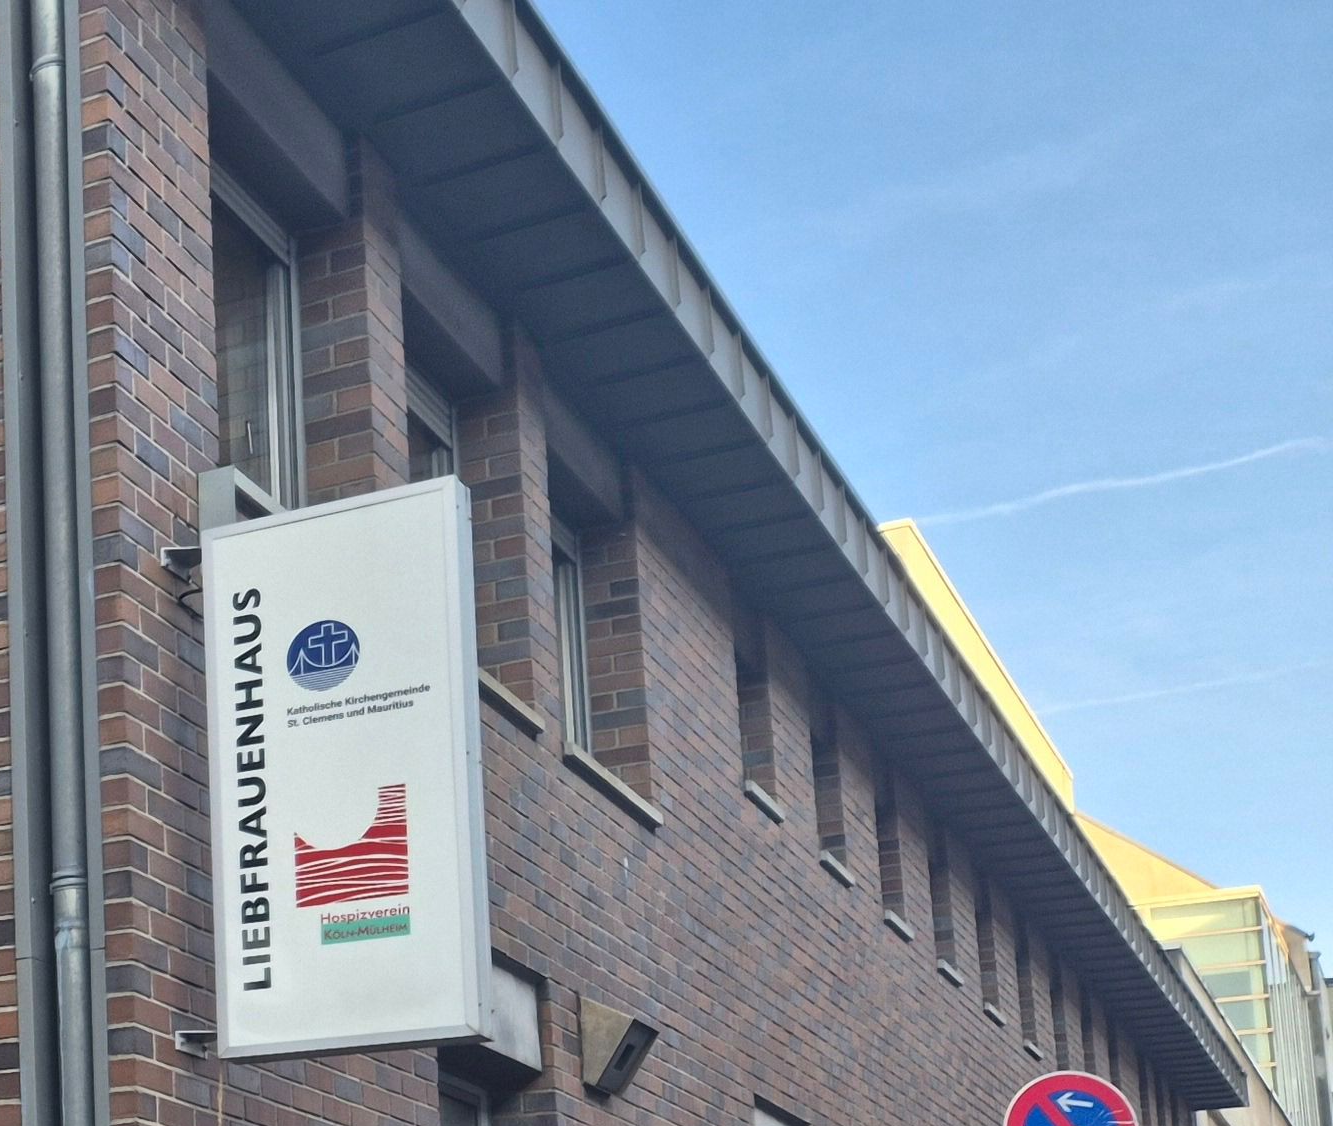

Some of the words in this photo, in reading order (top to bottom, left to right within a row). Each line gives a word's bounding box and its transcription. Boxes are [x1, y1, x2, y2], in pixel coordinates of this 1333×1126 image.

[286, 699, 343, 716] Katholische
[344, 683, 431, 706] Kirchengemeinde
[286, 718, 299, 728] St.
[302, 711, 345, 726] Clemens
[346, 707, 365, 718] und
[367, 699, 414, 715] Mauritius
[232, 587, 271, 991] LIEBFRAUENHAUS
[320, 904, 410, 925] Hospizverein
